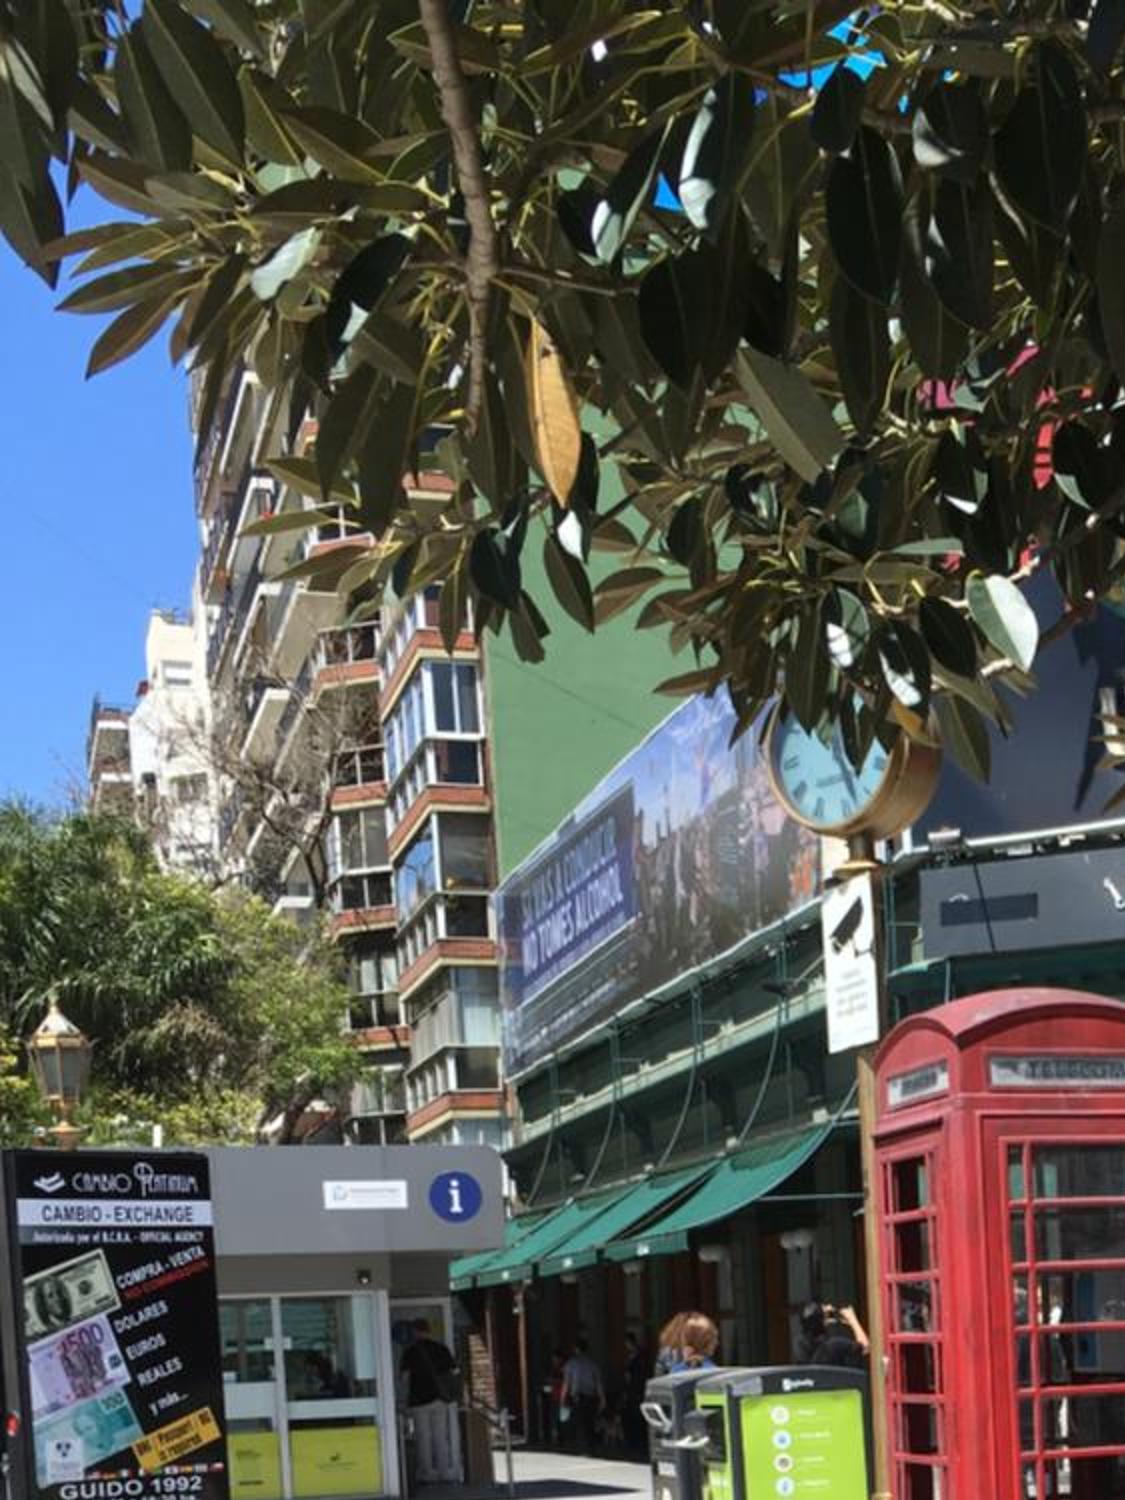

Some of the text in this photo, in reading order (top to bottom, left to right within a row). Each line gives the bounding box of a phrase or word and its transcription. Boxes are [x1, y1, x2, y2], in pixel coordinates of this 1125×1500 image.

[523, 929, 539, 977] NO
[538, 899, 576, 964] TOMES
[574, 861, 624, 936] ALCOHOL
[41, 1204, 101, 1223] CAMBIO
[113, 1204, 193, 1223] EXCHANGE
[113, 1300, 168, 1333] DOLARES
[125, 1333, 167, 1361] EUROS
[136, 1356, 184, 1387] REALES
[59, 1475, 203, 1500] GUIDO 1992
